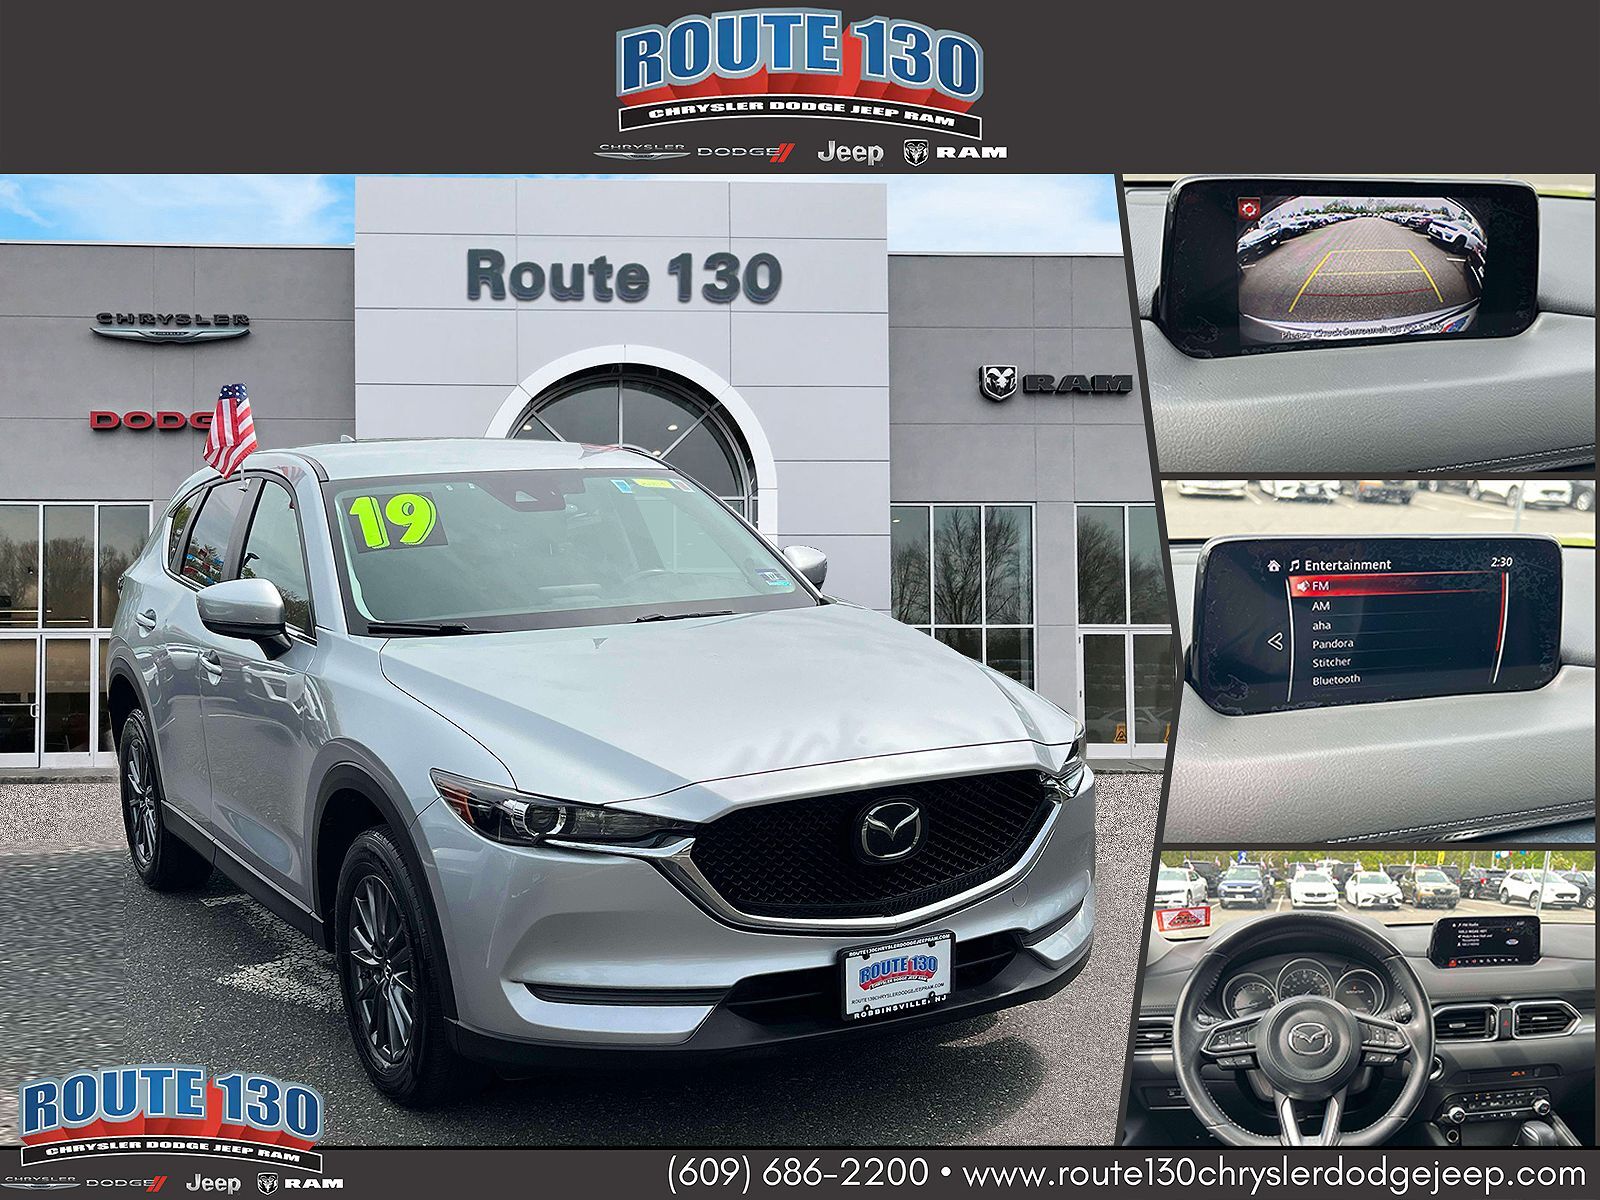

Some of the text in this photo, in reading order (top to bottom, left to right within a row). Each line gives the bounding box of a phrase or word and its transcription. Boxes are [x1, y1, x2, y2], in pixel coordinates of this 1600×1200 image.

[467, 248, 783, 304] Route 130
[96, 312, 250, 326] CHRYSLER
[1023, 374, 1133, 394] RAM
[90, 411, 215, 430] DODG
[349, 492, 437, 549] 19
[1305, 557, 1513, 572] Entertainment 2:30
[1312, 581, 1330, 591] FM
[1312, 601, 1330, 611] AM
[1312, 621, 1331, 631] aha
[1312, 638, 1354, 649] Pandora
[1312, 657, 1351, 668] Stitcher
[1312, 675, 1361, 686] Bluetooth
[859, 956, 908, 984] ROUTE
[911, 954, 939, 972] 130
[934, 994, 947, 1003] NJ
